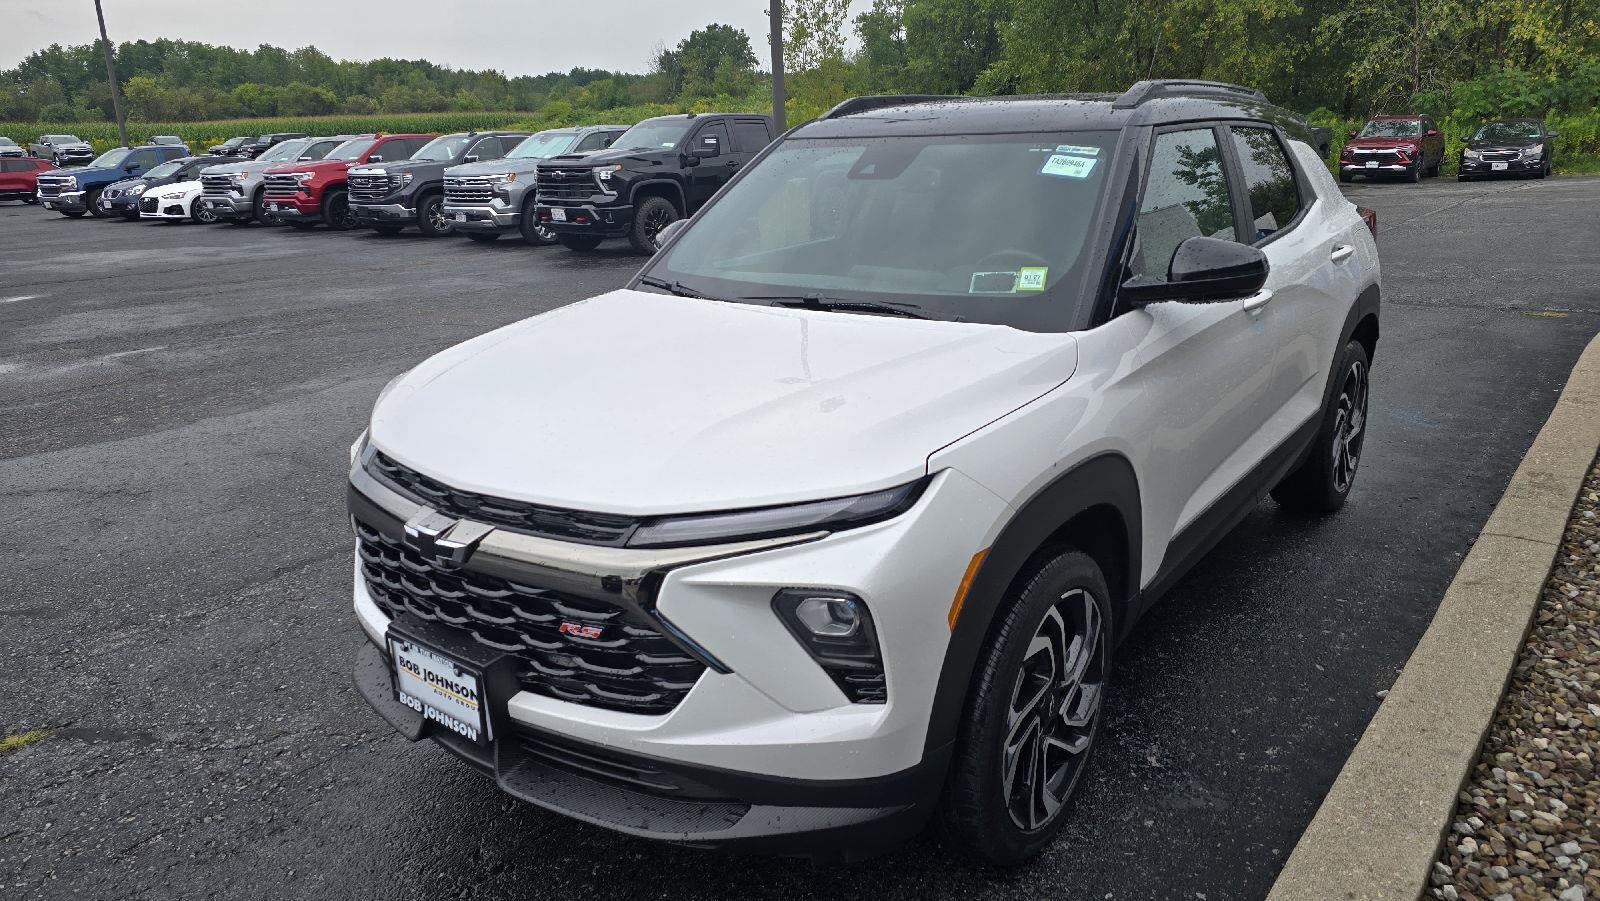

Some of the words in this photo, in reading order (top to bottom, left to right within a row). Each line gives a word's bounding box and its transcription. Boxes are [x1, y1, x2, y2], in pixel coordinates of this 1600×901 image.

[559, 622, 603, 639] RS
[399, 655, 421, 676] BOB
[423, 668, 478, 701] JOHNSON
[399, 691, 422, 712] BOB
[423, 704, 477, 742] JOHNSON
[433, 688, 452, 701] AUTO
[455, 698, 478, 712] GROU
